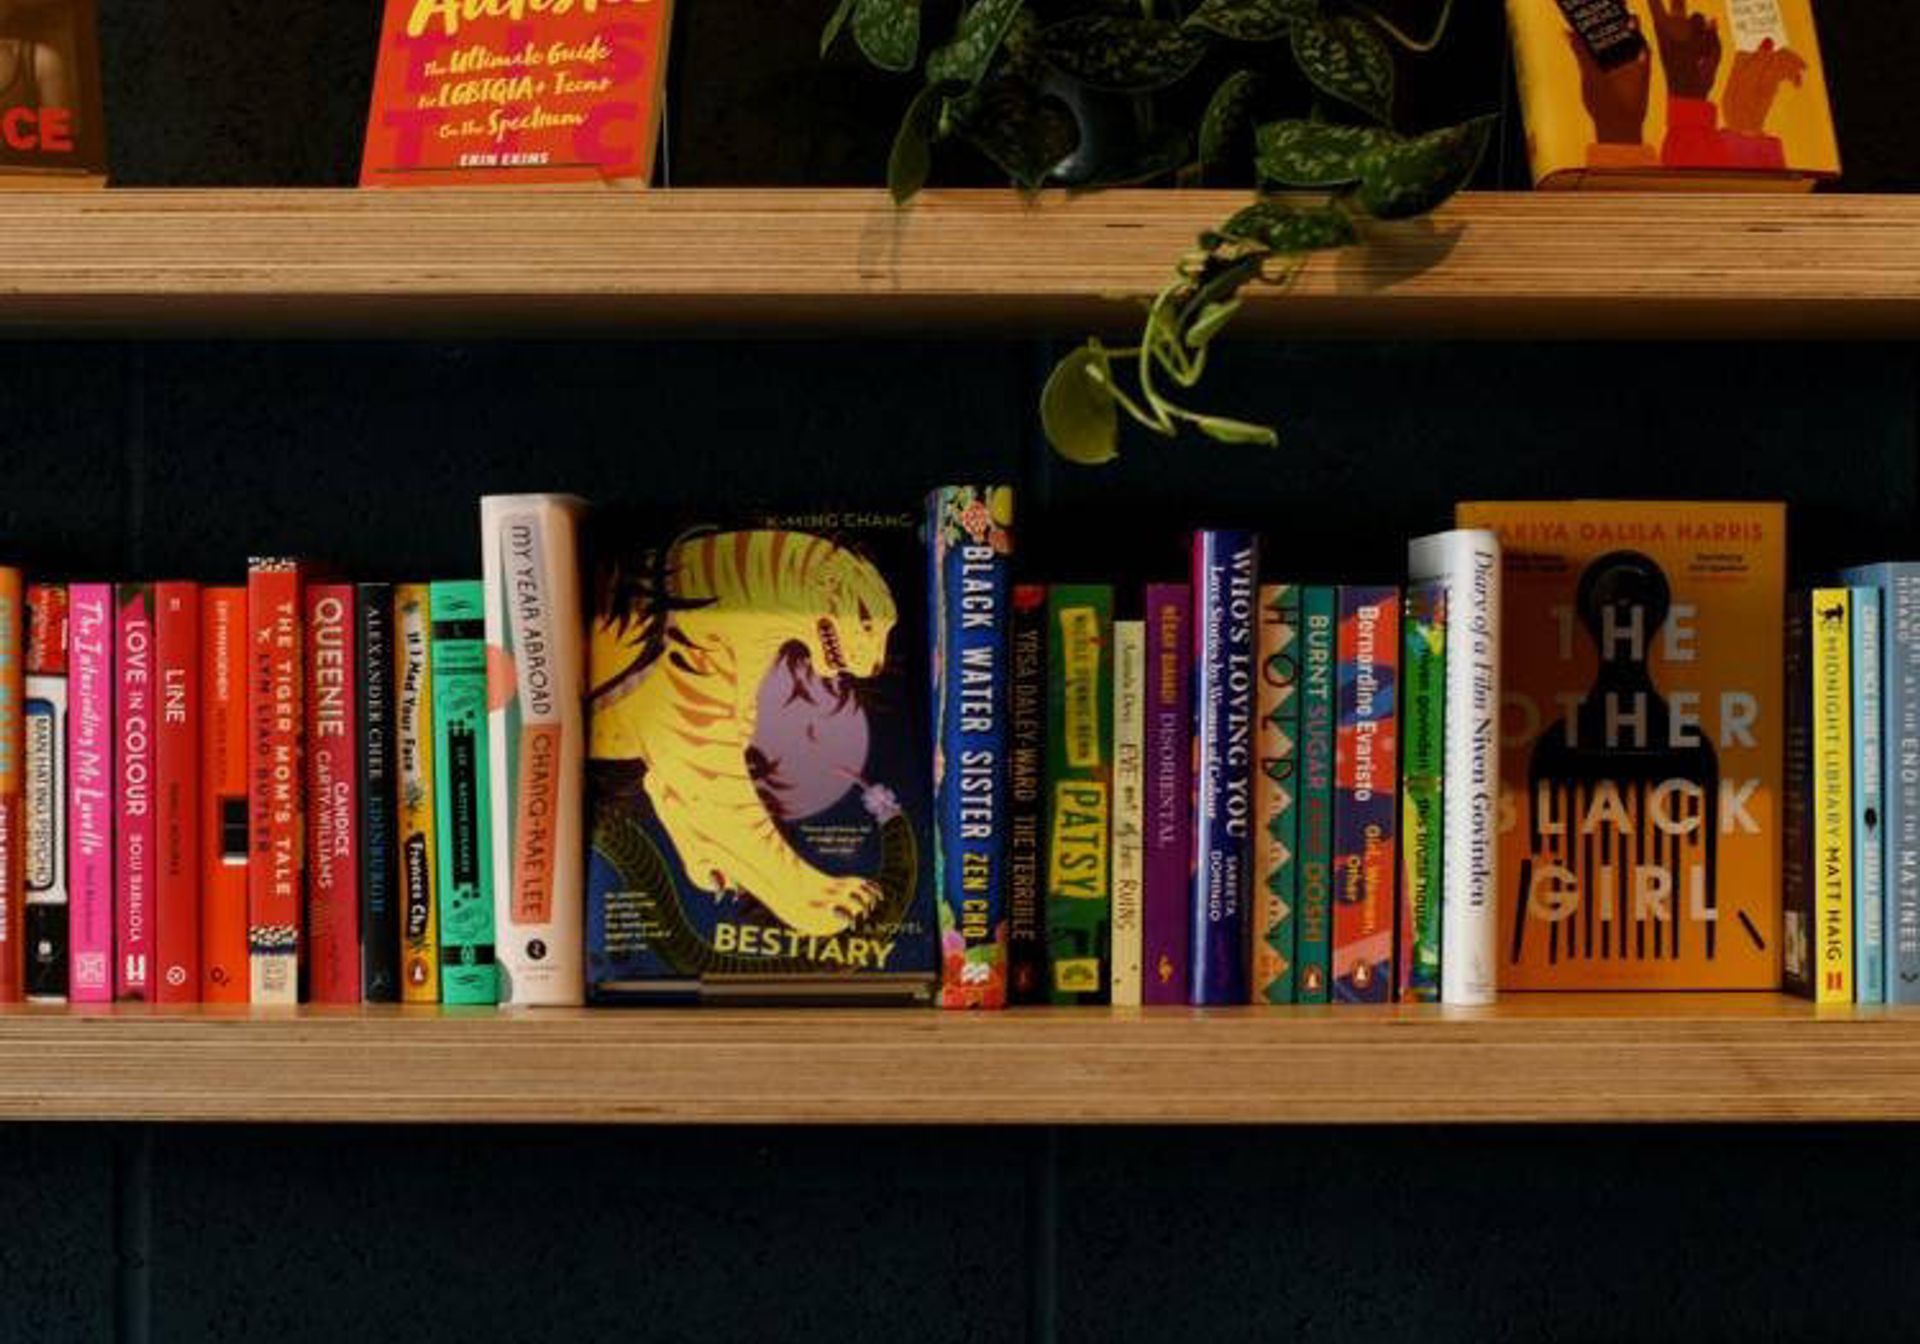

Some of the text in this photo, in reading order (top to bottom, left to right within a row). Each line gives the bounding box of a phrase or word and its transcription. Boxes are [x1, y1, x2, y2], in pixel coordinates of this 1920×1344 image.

[450, 43, 544, 74] Ultimate
[547, 36, 613, 66] Guide
[555, 71, 613, 95] Teens
[488, 106, 590, 143] Spectrum
[1482, 522, 1567, 542] AKIYA
[511, 525, 553, 716] MY YEAR ABROAD
[1304, 613, 1330, 699] BURNT
[1552, 604, 1699, 662] THE
[165, 668, 186, 724] LINE
[311, 596, 345, 738] QUEENIE
[366, 606, 384, 781] ALEXANDER CHEE
[404, 661, 421, 691] Had
[959, 545, 996, 839] BLACK WATER SISTER
[1225, 550, 1252, 839] WHO'S LOVING YOU
[1262, 603, 1301, 781] HOLD
[1353, 605, 1380, 803] Bernardine Evaristo
[35, 718, 49, 753] MAN
[124, 620, 148, 817] LOVE IN COLOUR
[257, 704, 272, 756] LIAO
[274, 602, 293, 896] THE TIGER MOM'S TALE
[402, 697, 416, 732] Your
[403, 738, 417, 772] Face
[1011, 629, 1042, 802] YRSA DALEY-WARD
[1304, 703, 1328, 790] SUGAR
[1470, 551, 1494, 908] Diary of a Film Niven Govinden
[1823, 636, 1841, 838] MIDNIGHT LIBRARY
[1901, 737, 1918, 783] END
[315, 749, 333, 890] CARTY-WILLIAMS
[333, 781, 350, 858] CANDICE
[522, 733, 553, 918] CHANG-RAE LEE
[1058, 788, 1102, 892] PATSY
[408, 841, 427, 937] Frances Cha
[961, 853, 990, 940] ZEN CHO
[1010, 814, 1038, 942] THE TERRIBLE
[1208, 849, 1224, 922] DOMINGO
[1303, 861, 1326, 943] DOSHI
[1345, 855, 1362, 902] Other
[1528, 861, 1719, 921] GIRL
[1825, 847, 1842, 962] MATT HAIG
[1900, 850, 1918, 953] MATINEE
[713, 920, 897, 970] BESTIARY
